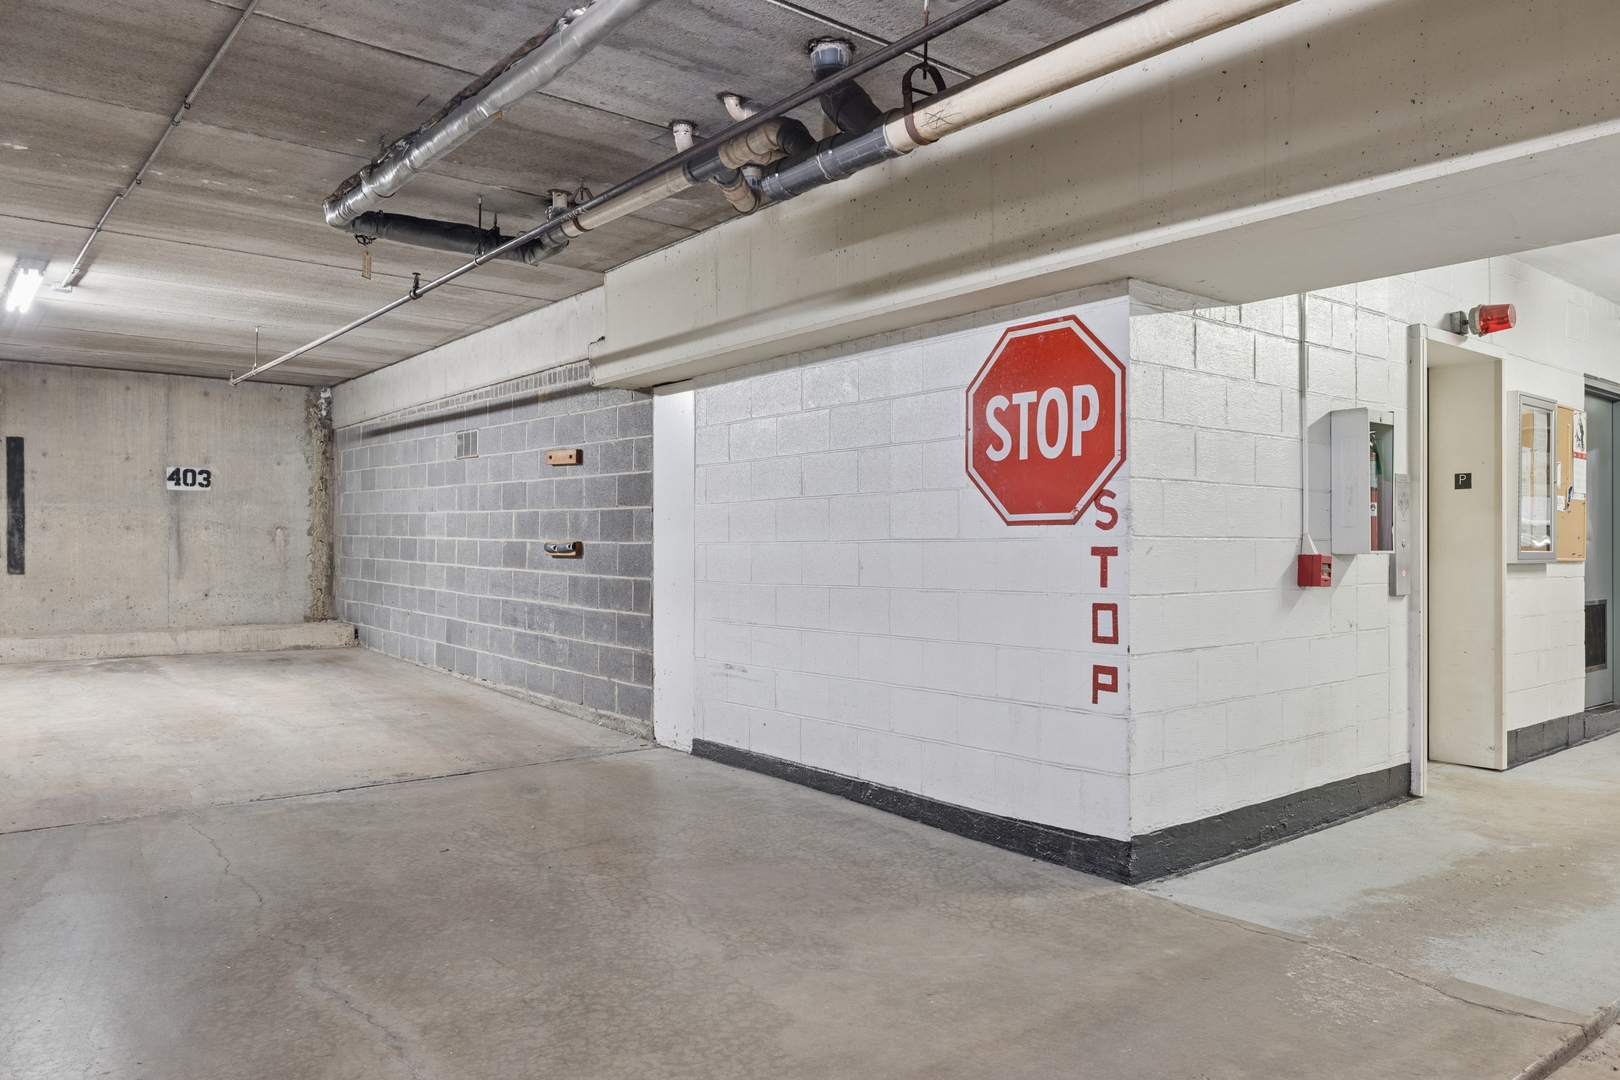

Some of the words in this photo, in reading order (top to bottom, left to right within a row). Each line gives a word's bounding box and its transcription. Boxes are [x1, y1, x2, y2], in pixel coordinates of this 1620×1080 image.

[985, 384, 1100, 462] STOP
[167, 467, 211, 488] 403
[1459, 474, 1467, 485] P
[1090, 489, 1119, 704] STOP
